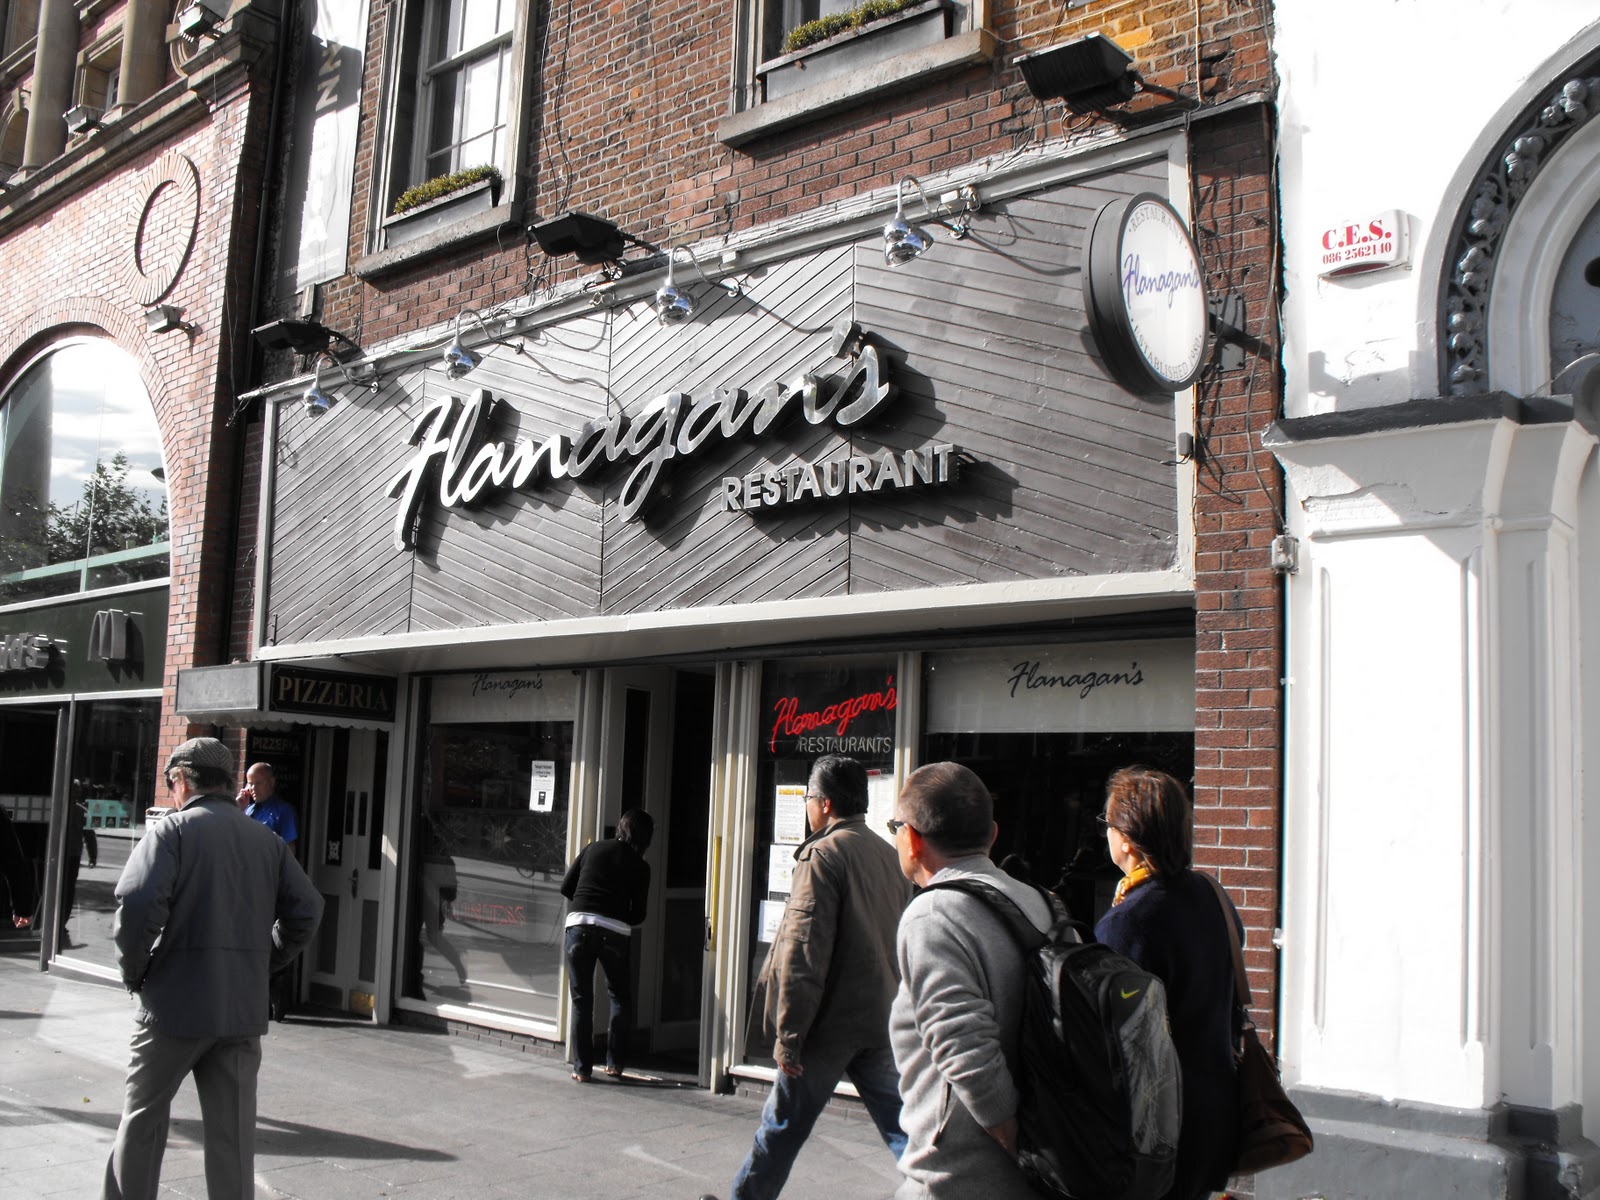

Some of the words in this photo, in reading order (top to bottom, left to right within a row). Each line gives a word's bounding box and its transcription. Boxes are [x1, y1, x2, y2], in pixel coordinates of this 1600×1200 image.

[1130, 206, 1184, 244] RESTAURANT
[1322, 219, 1392, 250] C.E.S.
[1322, 251, 1342, 265] 086
[1344, 241, 1392, 261] 2562140
[1123, 253, 1199, 310] Flanagan's
[385, 319, 890, 551] Flanagan's
[720, 443, 955, 511] RESTAURANT
[278, 675, 390, 711] PIZZERIA
[472, 672, 543, 699] Flanagan's
[1007, 660, 1144, 699] Flanagan's
[771, 675, 898, 753] Flanagan's
[797, 736, 892, 754] RESTAURANTS
